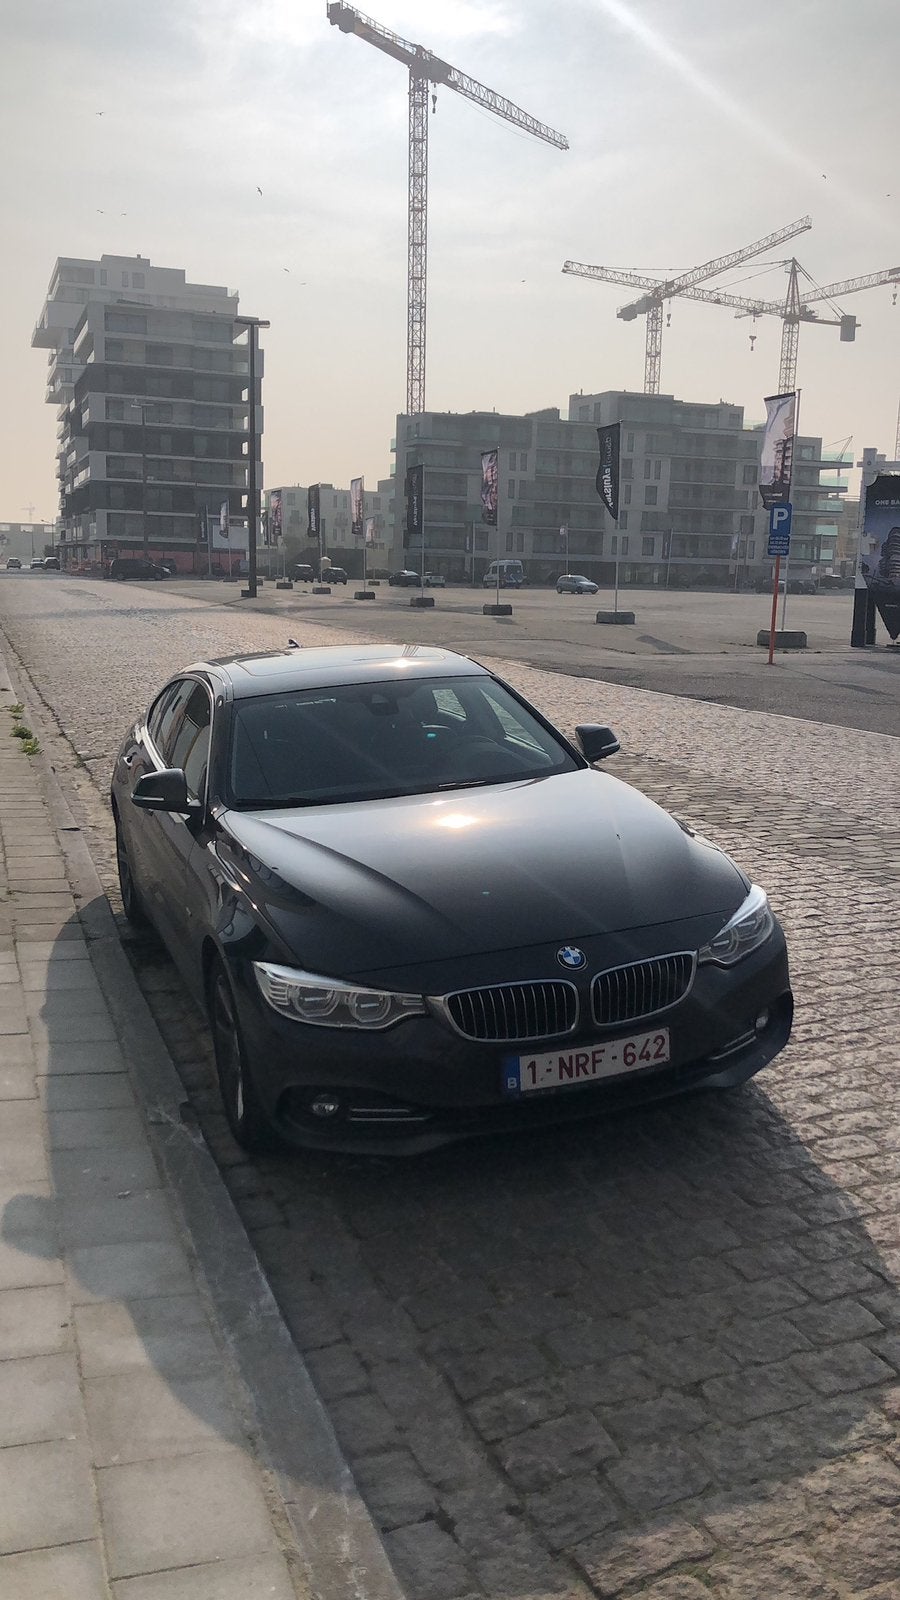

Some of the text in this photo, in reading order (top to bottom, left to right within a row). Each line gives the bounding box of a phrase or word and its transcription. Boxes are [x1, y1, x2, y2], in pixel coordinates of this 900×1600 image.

[773, 508, 788, 530] P
[527, 1035, 666, 1084] 1-NRF-642
[507, 1077, 518, 1089] B
